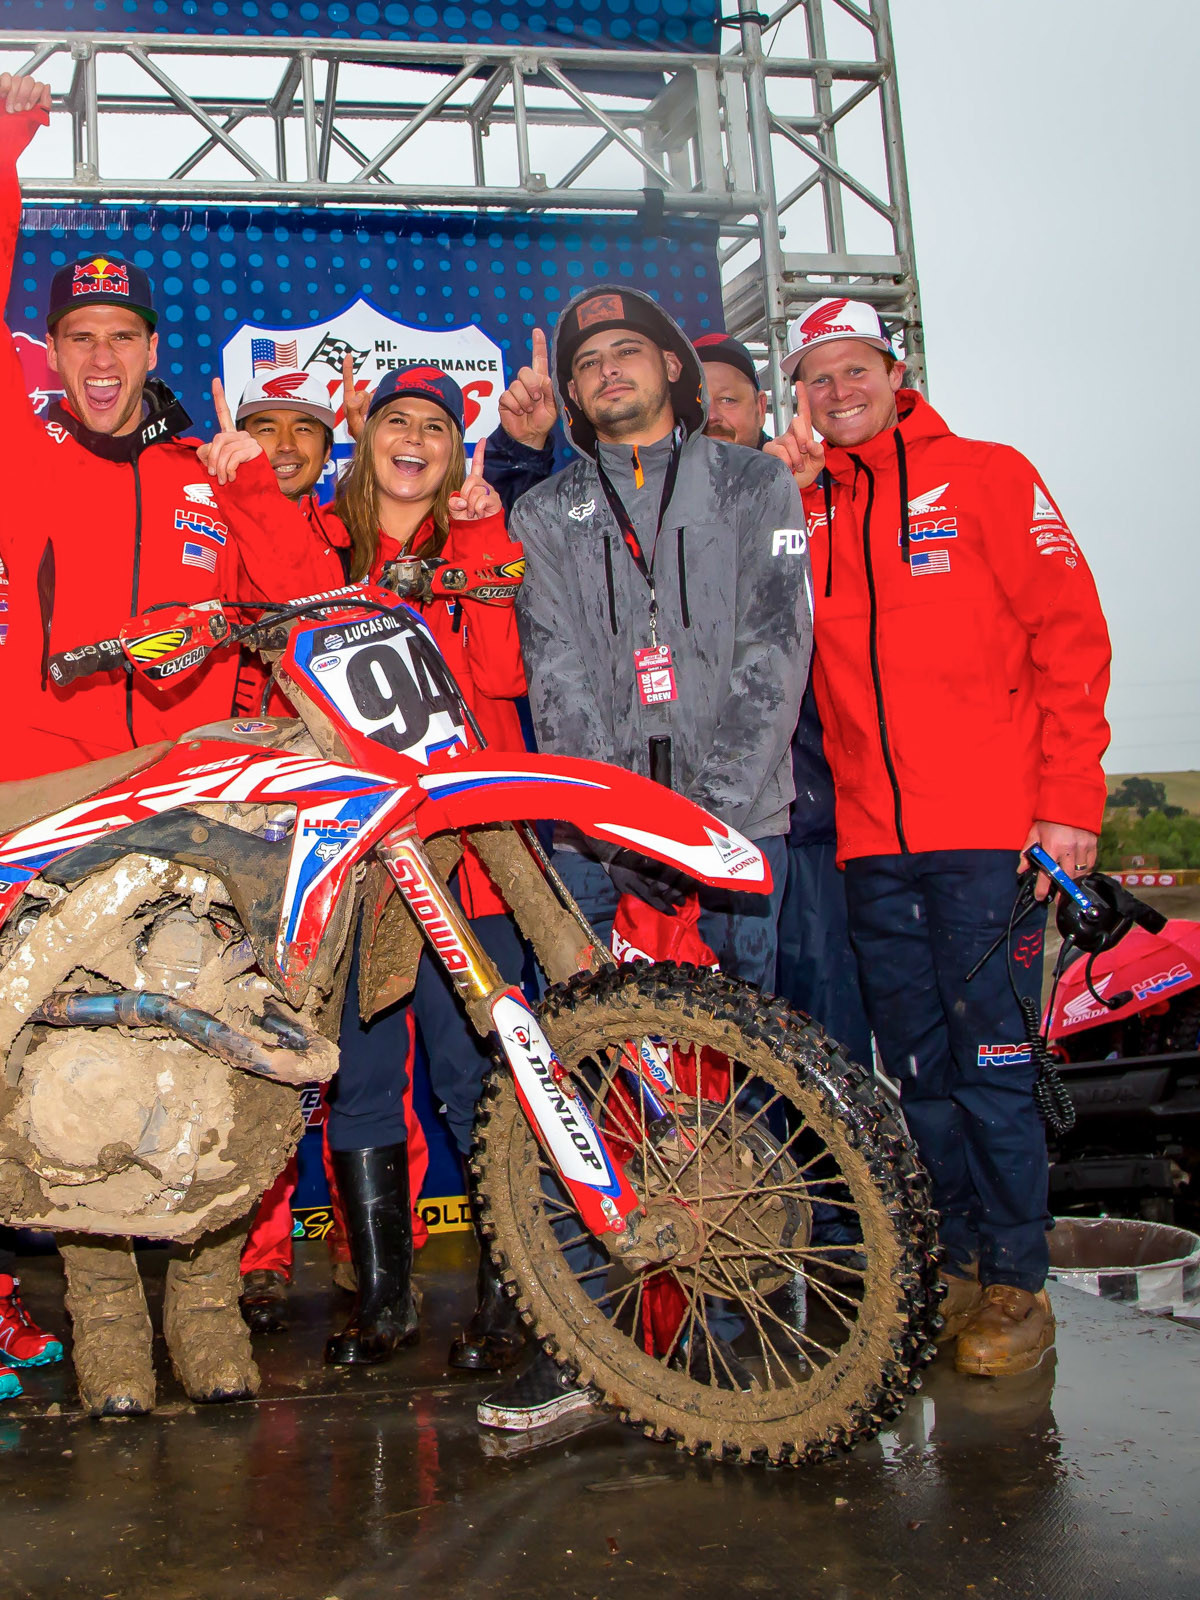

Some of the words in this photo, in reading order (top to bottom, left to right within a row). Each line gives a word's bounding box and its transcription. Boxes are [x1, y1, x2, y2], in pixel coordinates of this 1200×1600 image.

[72, 279, 100, 296] Red
[102, 279, 129, 296] Bull
[374, 340, 398, 352] HI-
[802, 325, 856, 345] HONDA
[394, 382, 445, 400] HONDA
[141, 417, 169, 444] FOX
[185, 495, 219, 509] HOND
[908, 505, 947, 517] HONDA
[174, 508, 229, 547] HRC
[344, 618, 384, 644] LUCAS
[382, 616, 401, 631] OIL
[345, 625, 467, 753] 94
[646, 691, 671, 703] CREW
[303, 818, 360, 839] HRC
[727, 855, 761, 876] HONDA
[384, 856, 472, 973] SHOWA
[1130, 962, 1193, 1001] HRC
[1062, 1006, 1109, 1028] HONDA
[977, 1042, 1034, 1067] HRC
[526, 1055, 603, 1171] DUNLOP
[418, 1203, 472, 1227] OLD
